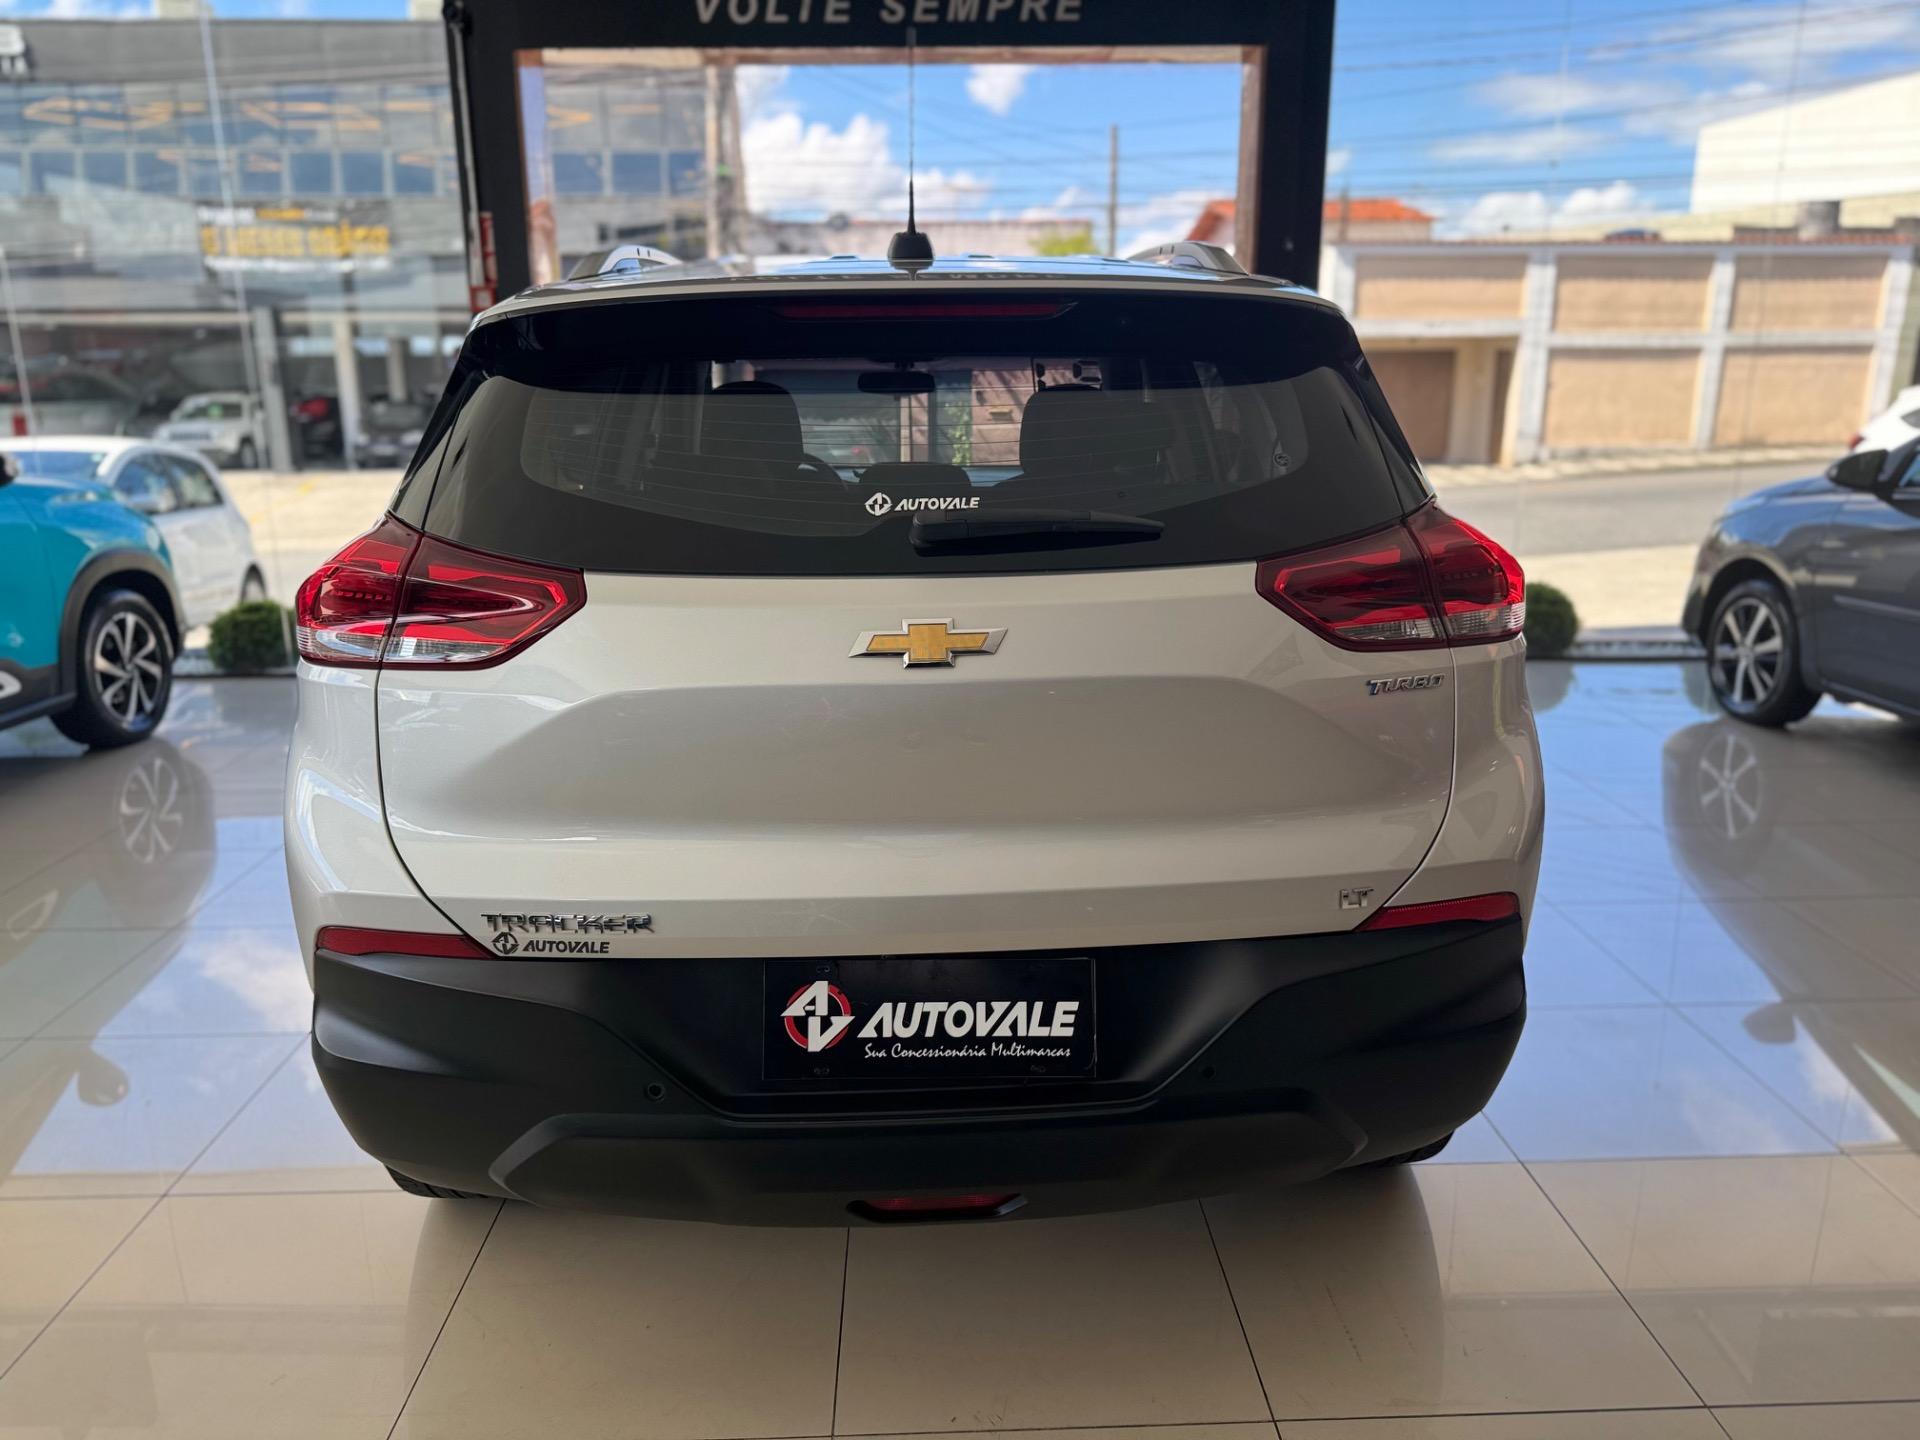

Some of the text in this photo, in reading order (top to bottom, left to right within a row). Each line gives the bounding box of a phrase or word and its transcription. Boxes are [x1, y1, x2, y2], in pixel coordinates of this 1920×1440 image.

[695, 0, 1082, 24] VOLTE SEMPRE
[894, 497, 980, 511] AUTOVALE
[1366, 673, 1446, 696] TURBO
[1339, 887, 1374, 909] LT
[480, 913, 655, 934] TRACKER
[522, 940, 610, 954] AUTOVALE
[856, 1001, 1080, 1038] AUTOVALE
[864, 1041, 1071, 1059] Sua Concessionária Multimarcas
